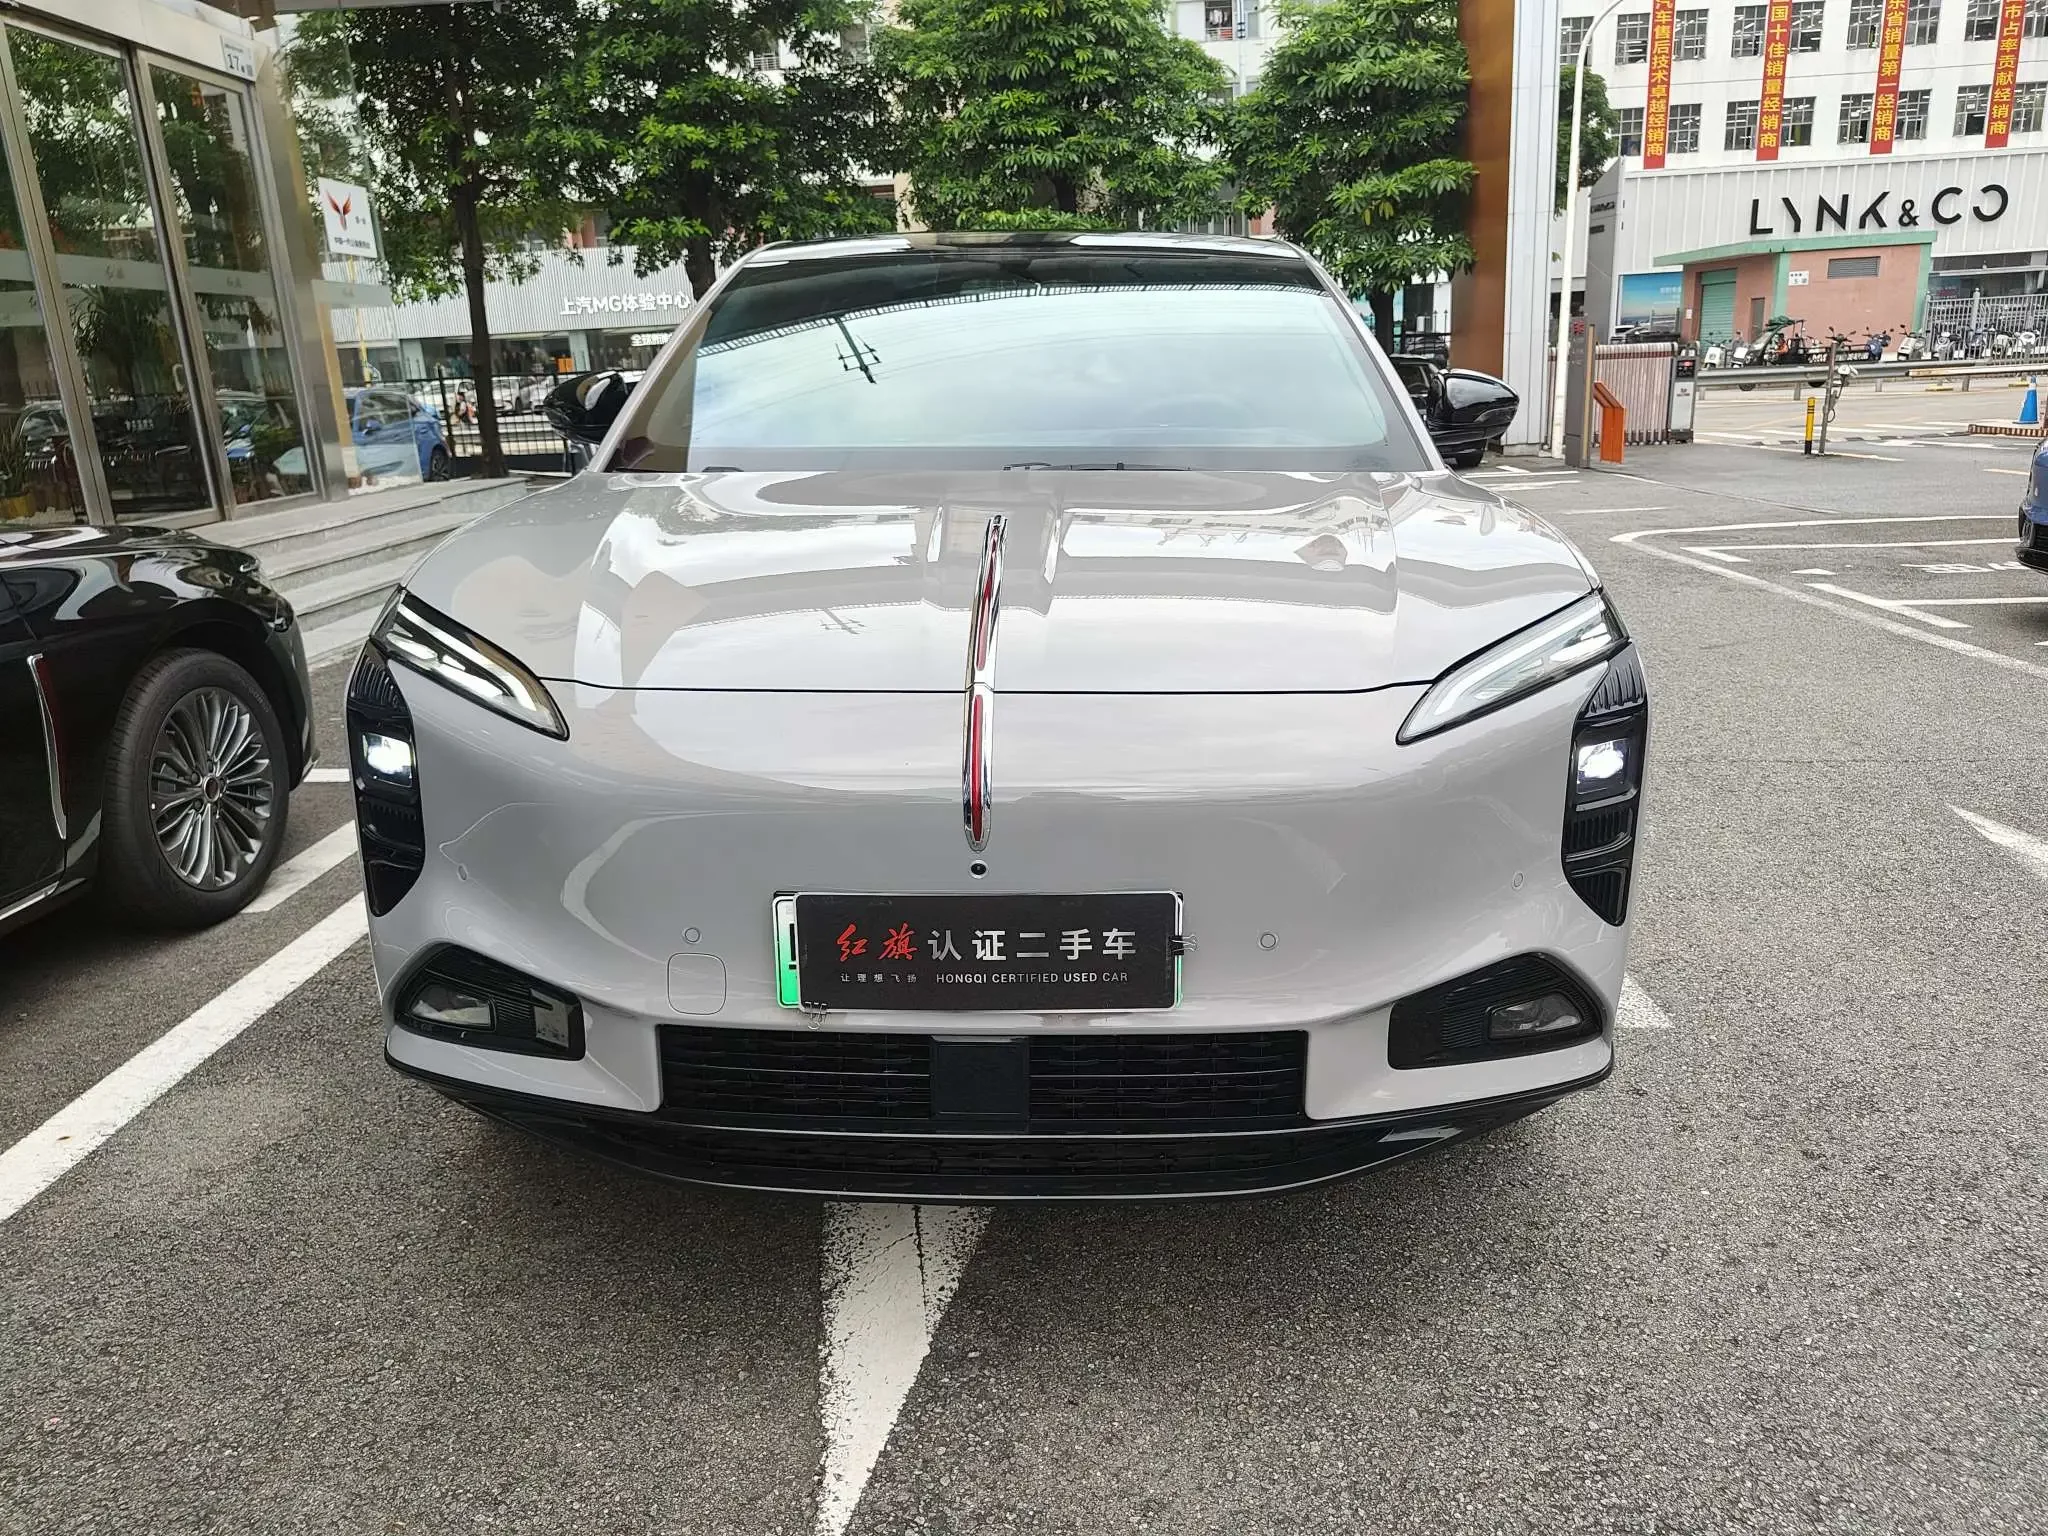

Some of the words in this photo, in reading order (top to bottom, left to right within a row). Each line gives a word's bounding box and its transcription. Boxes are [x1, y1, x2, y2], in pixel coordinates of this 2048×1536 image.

[1760, 0, 1789, 148] 国十佳销量经销商
[1989, 0, 2023, 135] 市占率贡献经销商
[560, 291, 691, 316] 上汽MG体验中心
[840, 973, 917, 984] 让理想飞扬
[936, 973, 987, 984] HONGQI
[991, 973, 1059, 983] CERTIFIED
[1063, 972, 1098, 982] USED
[1102, 972, 1128, 982] CAR
